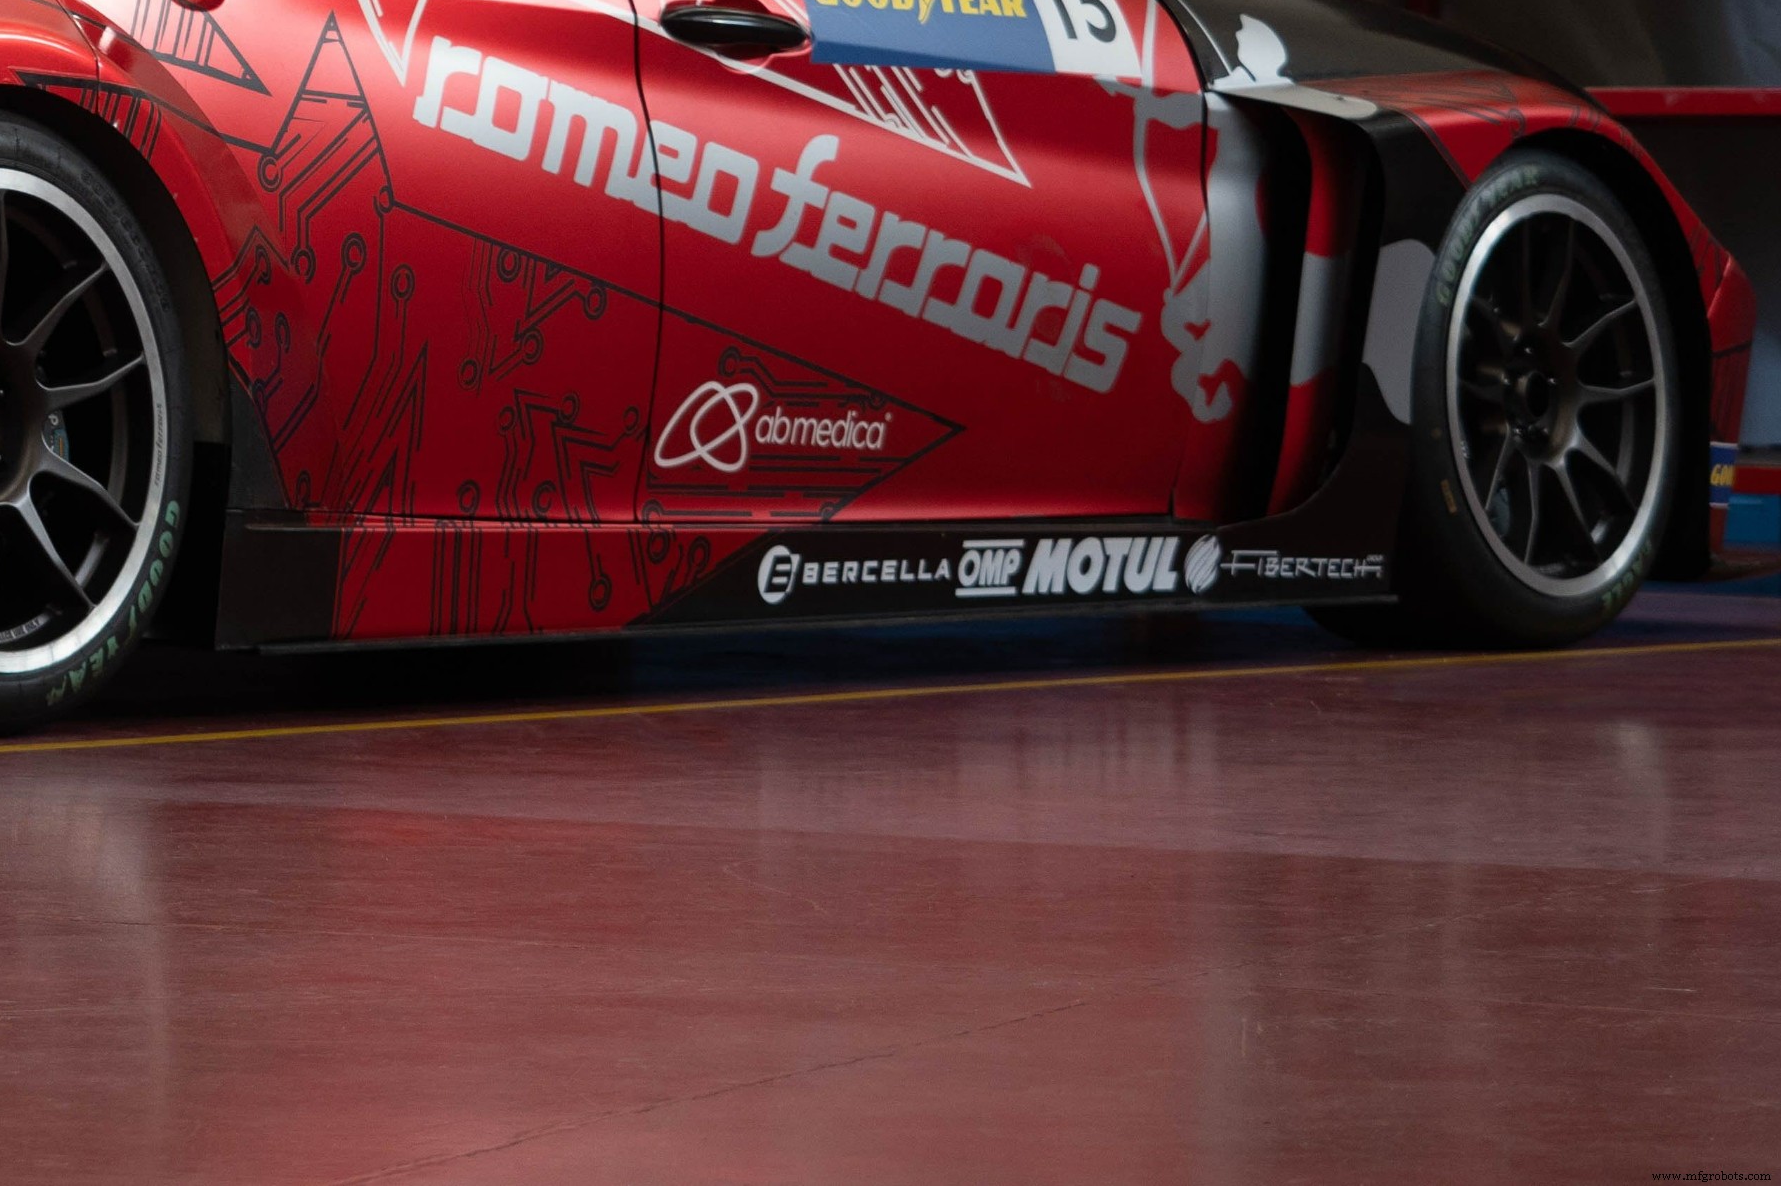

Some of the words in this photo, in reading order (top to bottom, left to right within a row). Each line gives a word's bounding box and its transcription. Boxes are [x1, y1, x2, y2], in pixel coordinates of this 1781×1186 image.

[802, 558, 951, 584] BERCELLA
[957, 548, 1021, 587] OMP
[1021, 536, 1181, 595] MOTUL
